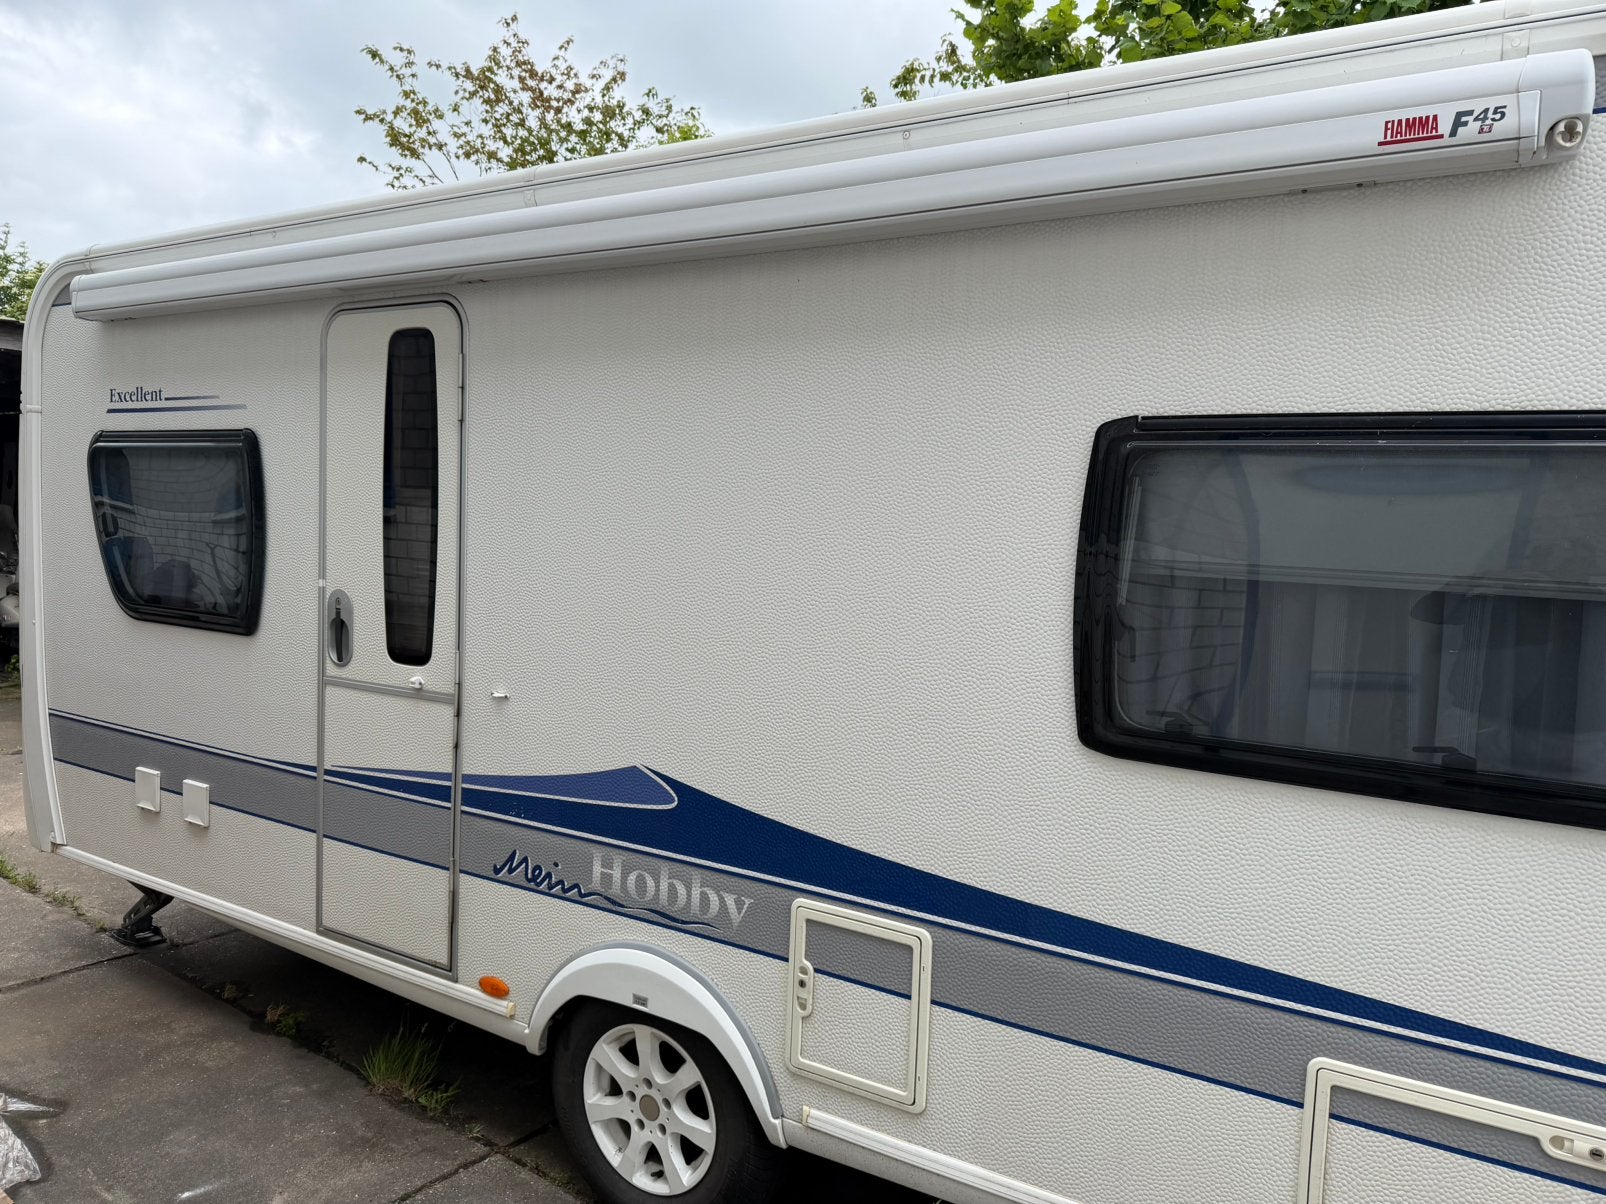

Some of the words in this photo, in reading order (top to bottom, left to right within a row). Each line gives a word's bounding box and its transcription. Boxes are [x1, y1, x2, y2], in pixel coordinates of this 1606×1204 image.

[1383, 113, 1440, 140] FIAMMA
[1448, 105, 1507, 138] F45
[109, 386, 163, 403] Excellent
[493, 849, 592, 899] Mein
[591, 851, 754, 930] Hobby
